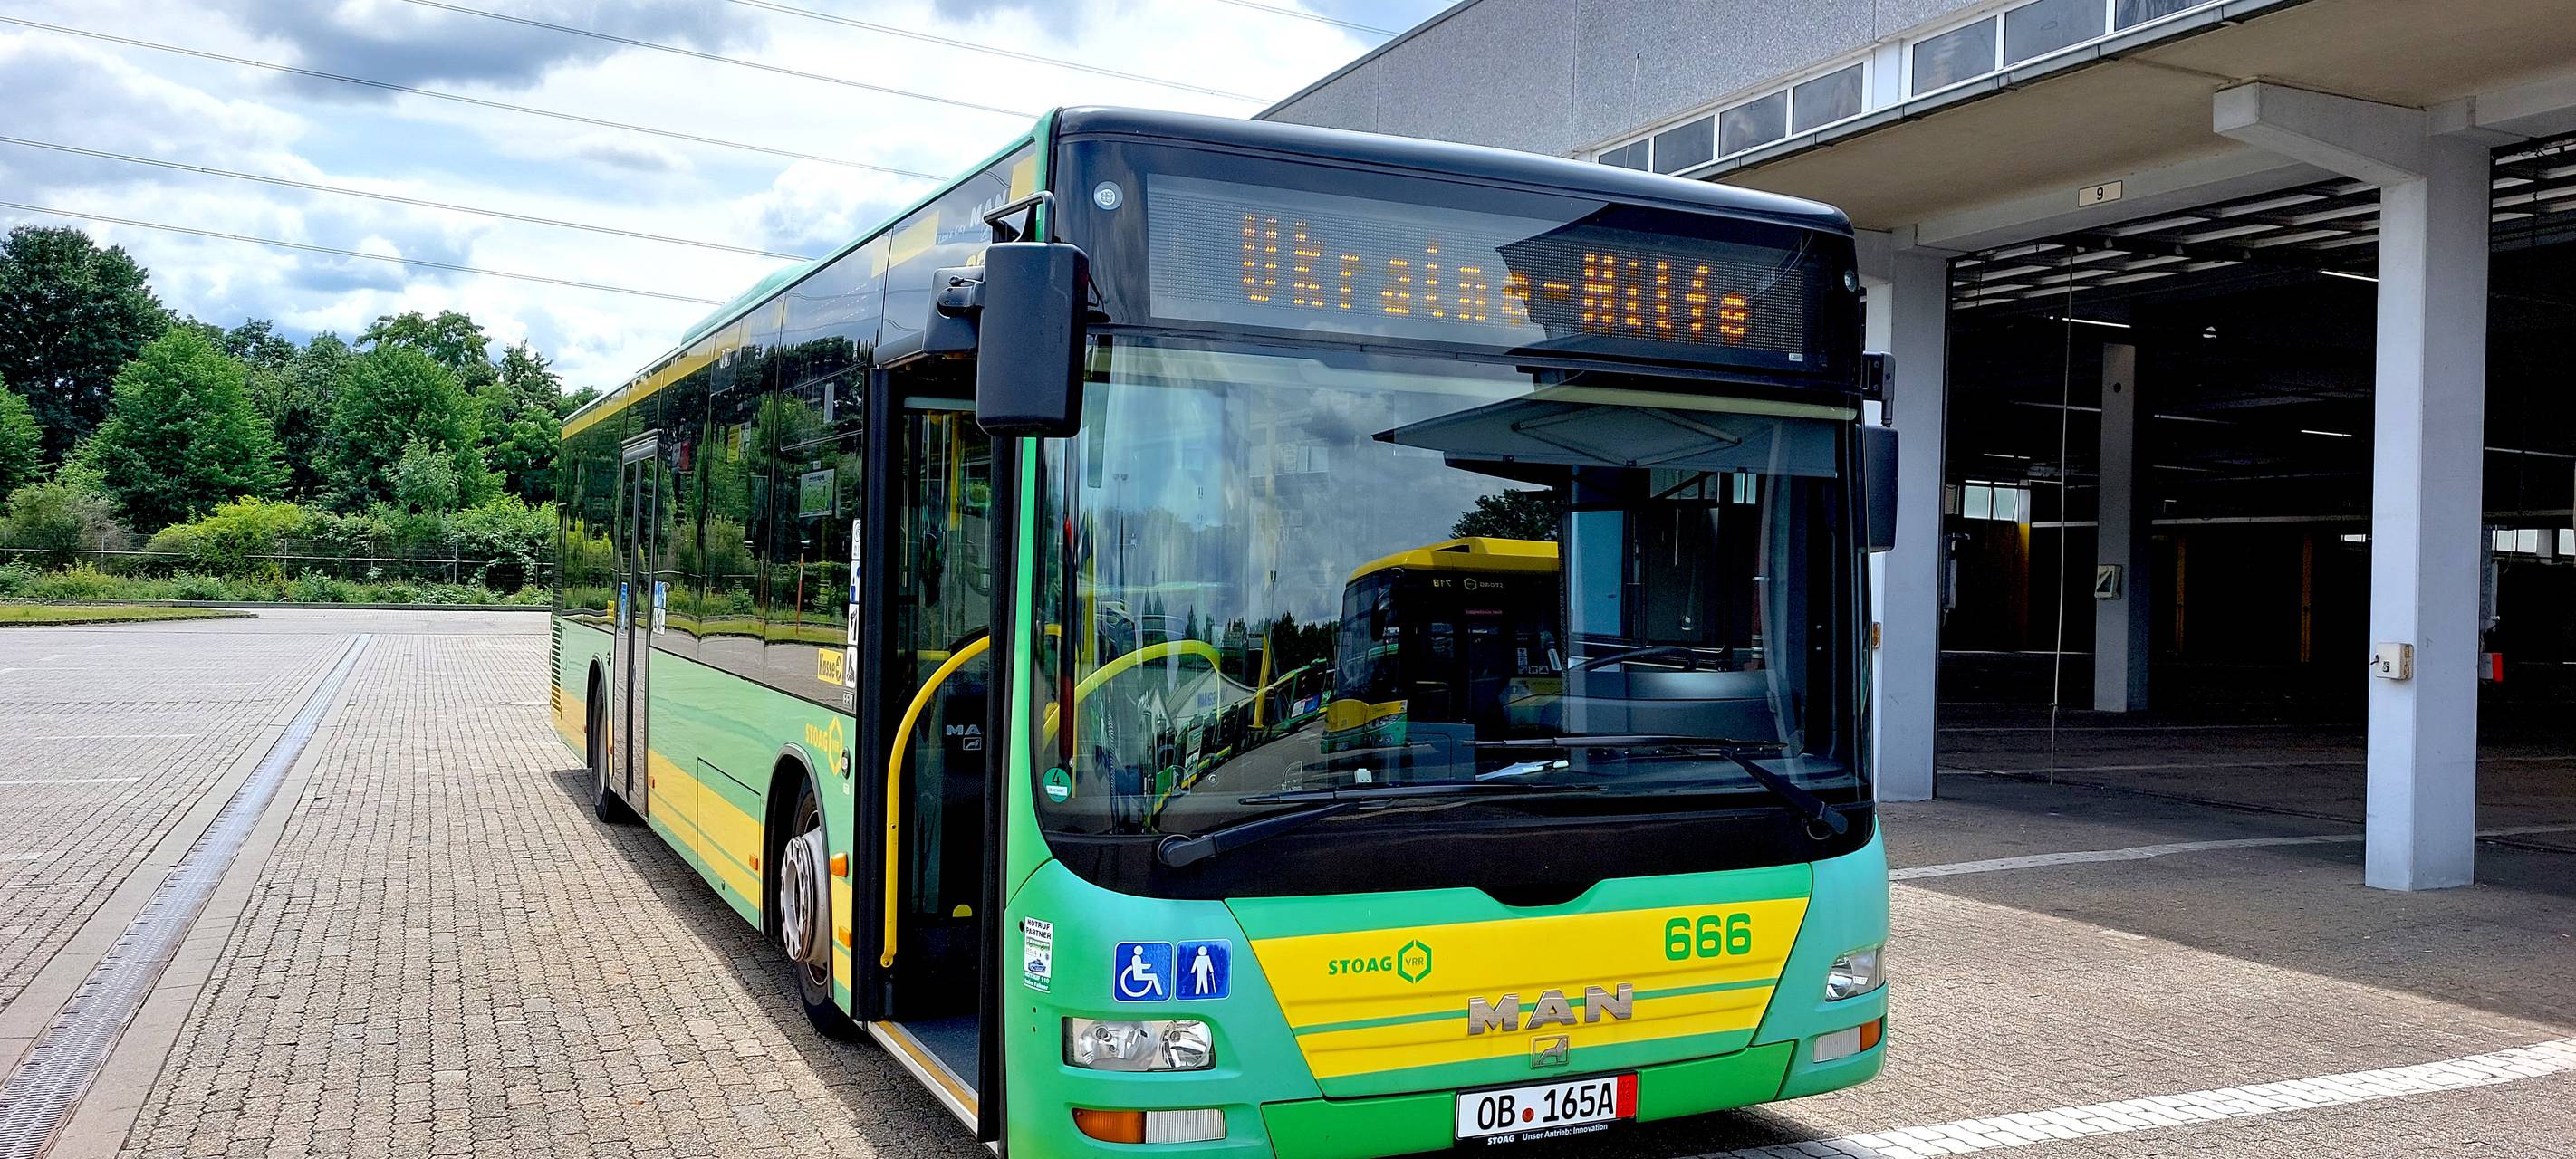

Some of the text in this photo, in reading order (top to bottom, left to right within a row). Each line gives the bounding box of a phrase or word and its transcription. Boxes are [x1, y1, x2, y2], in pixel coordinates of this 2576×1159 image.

[2097, 187, 2104, 200] 9
[1242, 216, 1746, 336] Ukraine-Hilfe
[820, 652, 835, 679] Kasse
[805, 723, 829, 754] STOAG
[946, 724, 984, 735] MA
[1052, 769, 1060, 785] 4
[1025, 927, 1052, 939] PARTNER
[1027, 918, 1051, 930] NOTRUF
[1665, 913, 1751, 961] 666
[1328, 956, 1424, 975] STOAG VRR
[1468, 982, 1633, 1035] MAN
[1477, 1082, 1614, 1130] OB 165A
[1487, 1124, 1608, 1145] STOAG Unser Antrieb: Innovation
